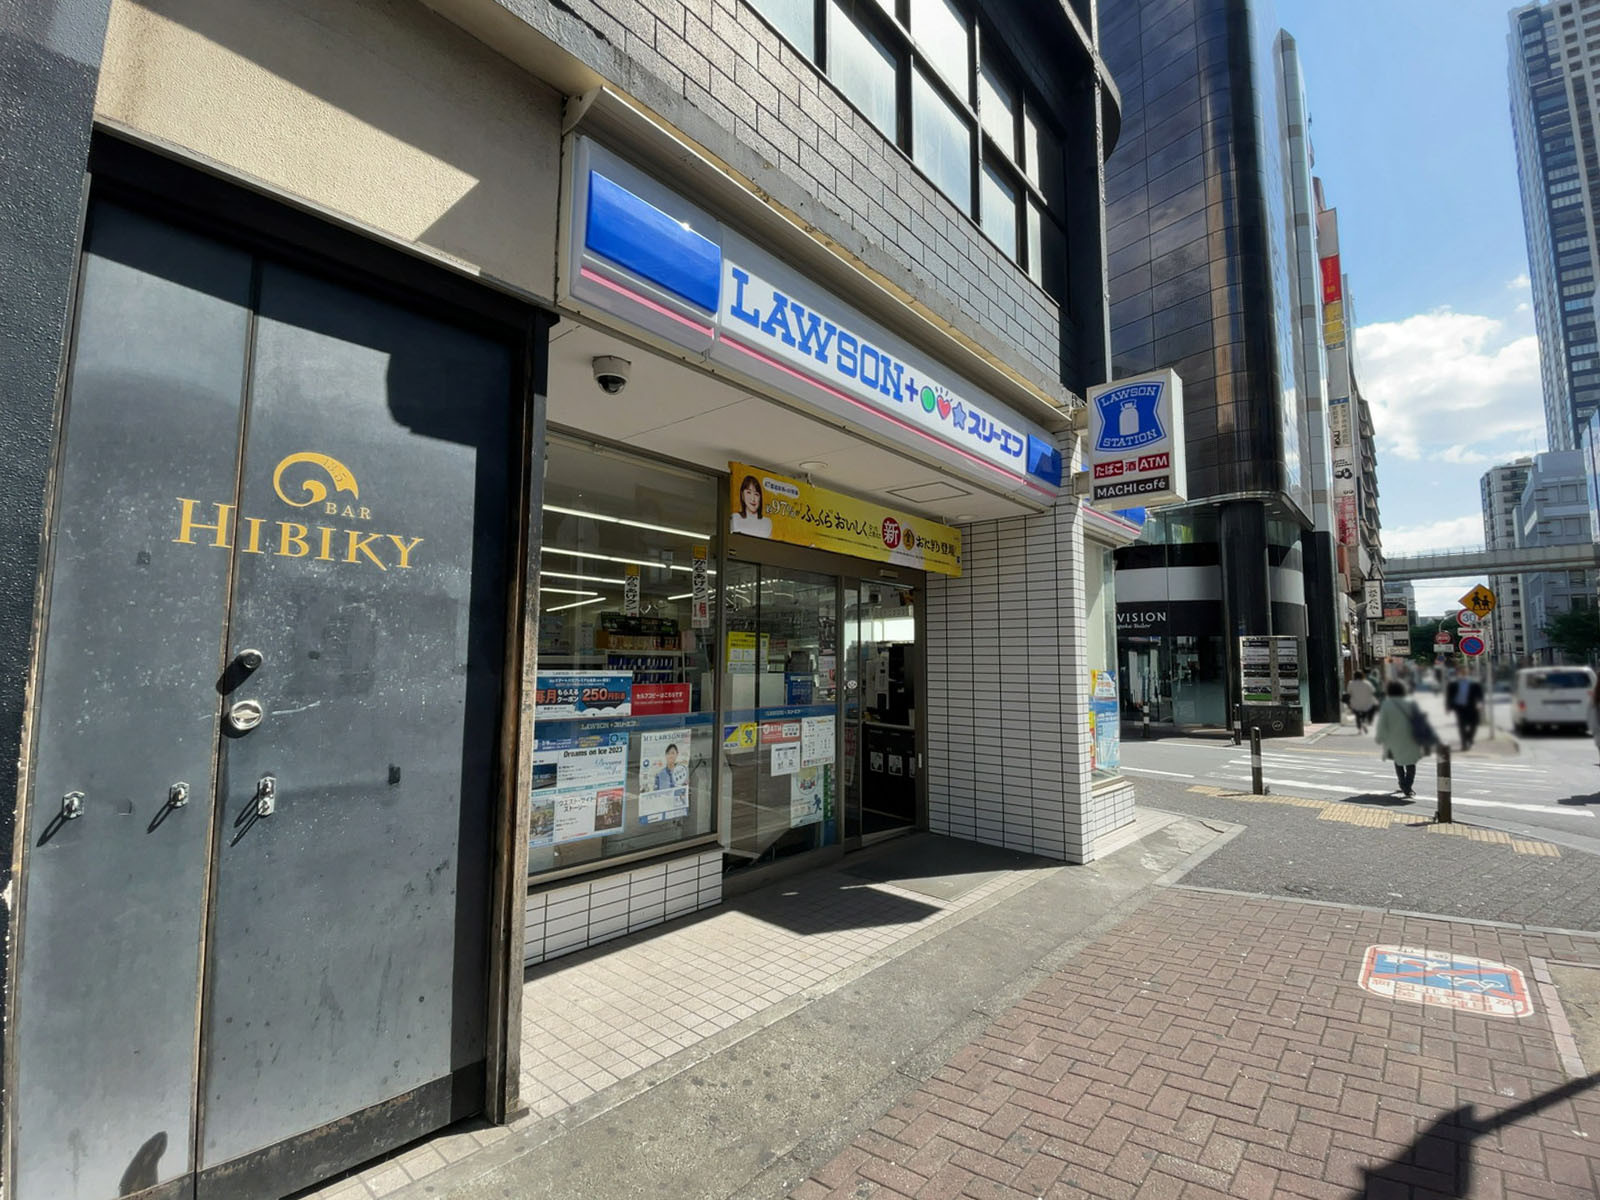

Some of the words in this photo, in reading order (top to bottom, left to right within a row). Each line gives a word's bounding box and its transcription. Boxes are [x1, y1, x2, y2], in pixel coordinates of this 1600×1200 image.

[1101, 386, 1158, 407] LAWSON
[1102, 429, 1158, 447] STATION
[1095, 463, 1123, 477] たばこ
[1139, 455, 1168, 471] ATM
[1097, 482, 1137, 498] MACHI
[1138, 479, 1166, 491] café
[325, 502, 372, 520] BAR
[172, 497, 425, 572] HIBIKY
[883, 520, 900, 545] 新
[1117, 612, 1167, 623] VISION
[1463, 612, 1476, 623] 30
[563, 749, 588, 758] Dreams
[597, 747, 607, 755] Ice
